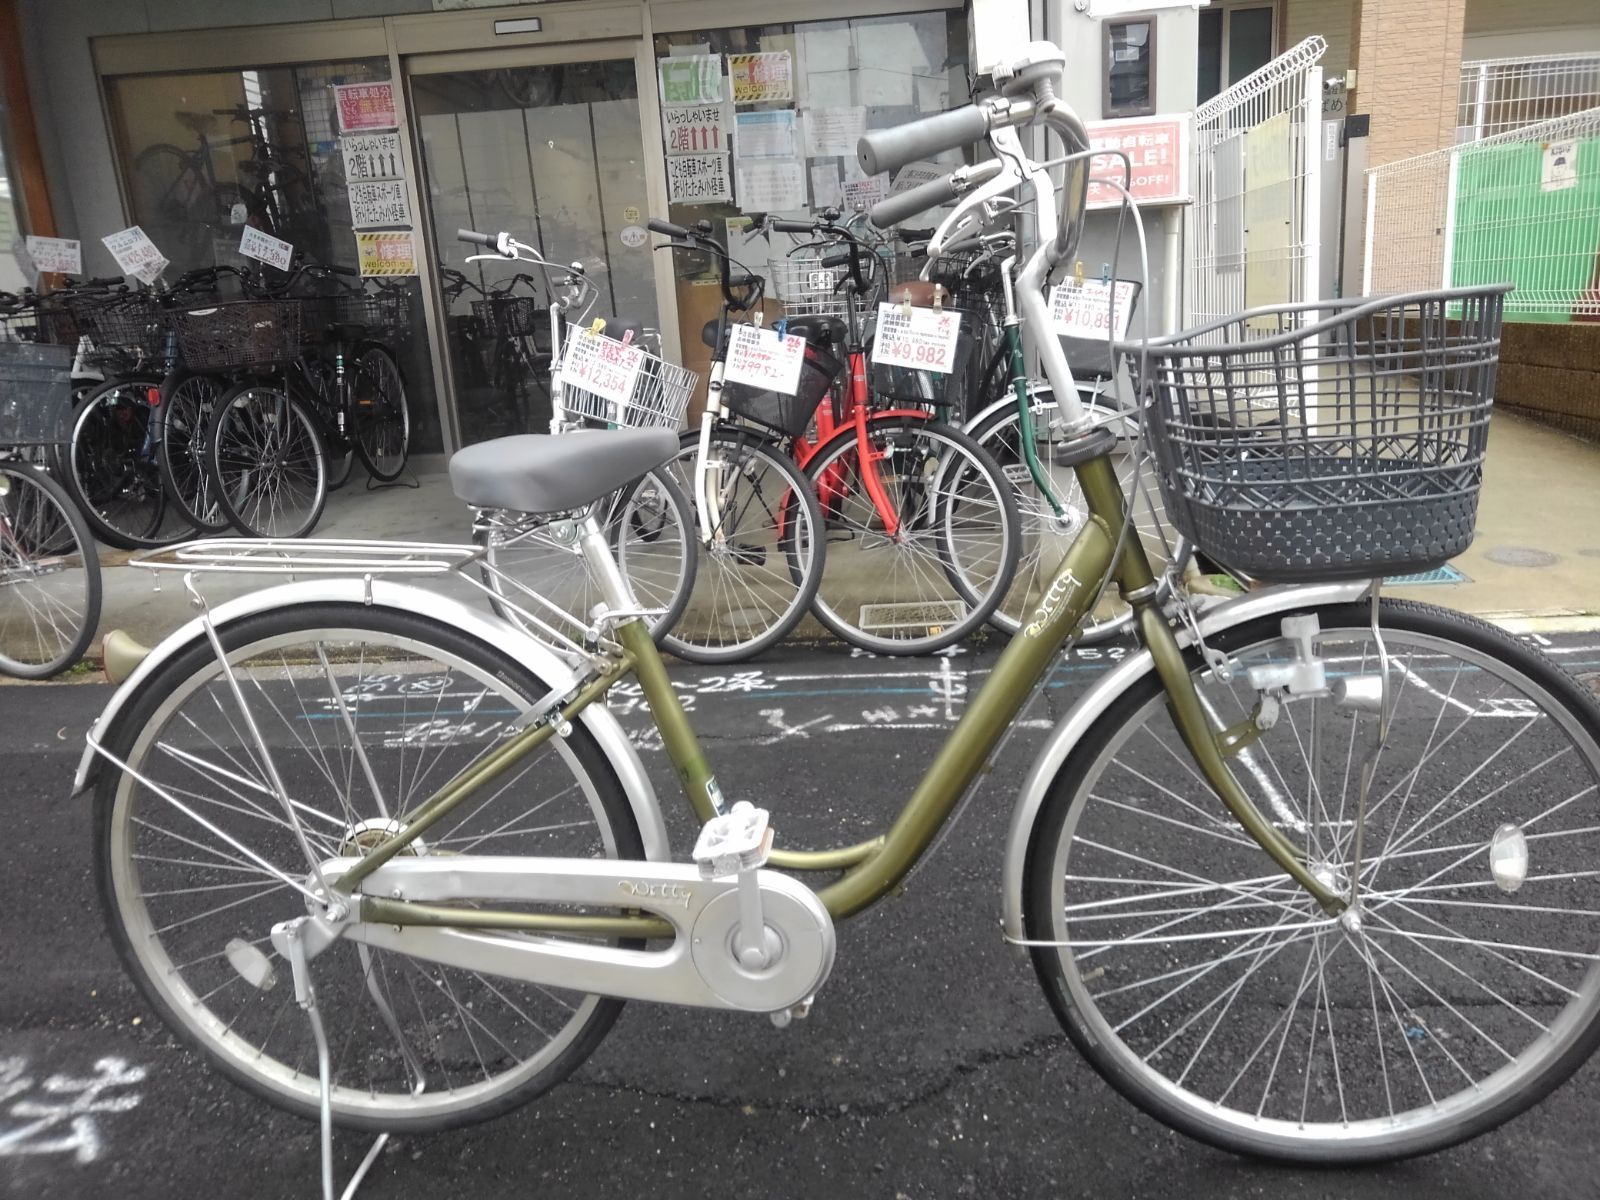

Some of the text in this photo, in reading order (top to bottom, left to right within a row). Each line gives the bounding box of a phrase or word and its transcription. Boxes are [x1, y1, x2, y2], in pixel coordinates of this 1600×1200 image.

[339, 86, 392, 101] 自転車処分
[666, 108, 720, 124] いらっしゃいませ
[344, 136, 396, 152] いらっしゃいませ
[670, 126, 689, 150] 2階
[349, 154, 369, 178] 2階
[1092, 148, 1168, 171] SALE!
[892, 342, 946, 365] ¥9,982
[578, 363, 626, 394] ¥12,354
